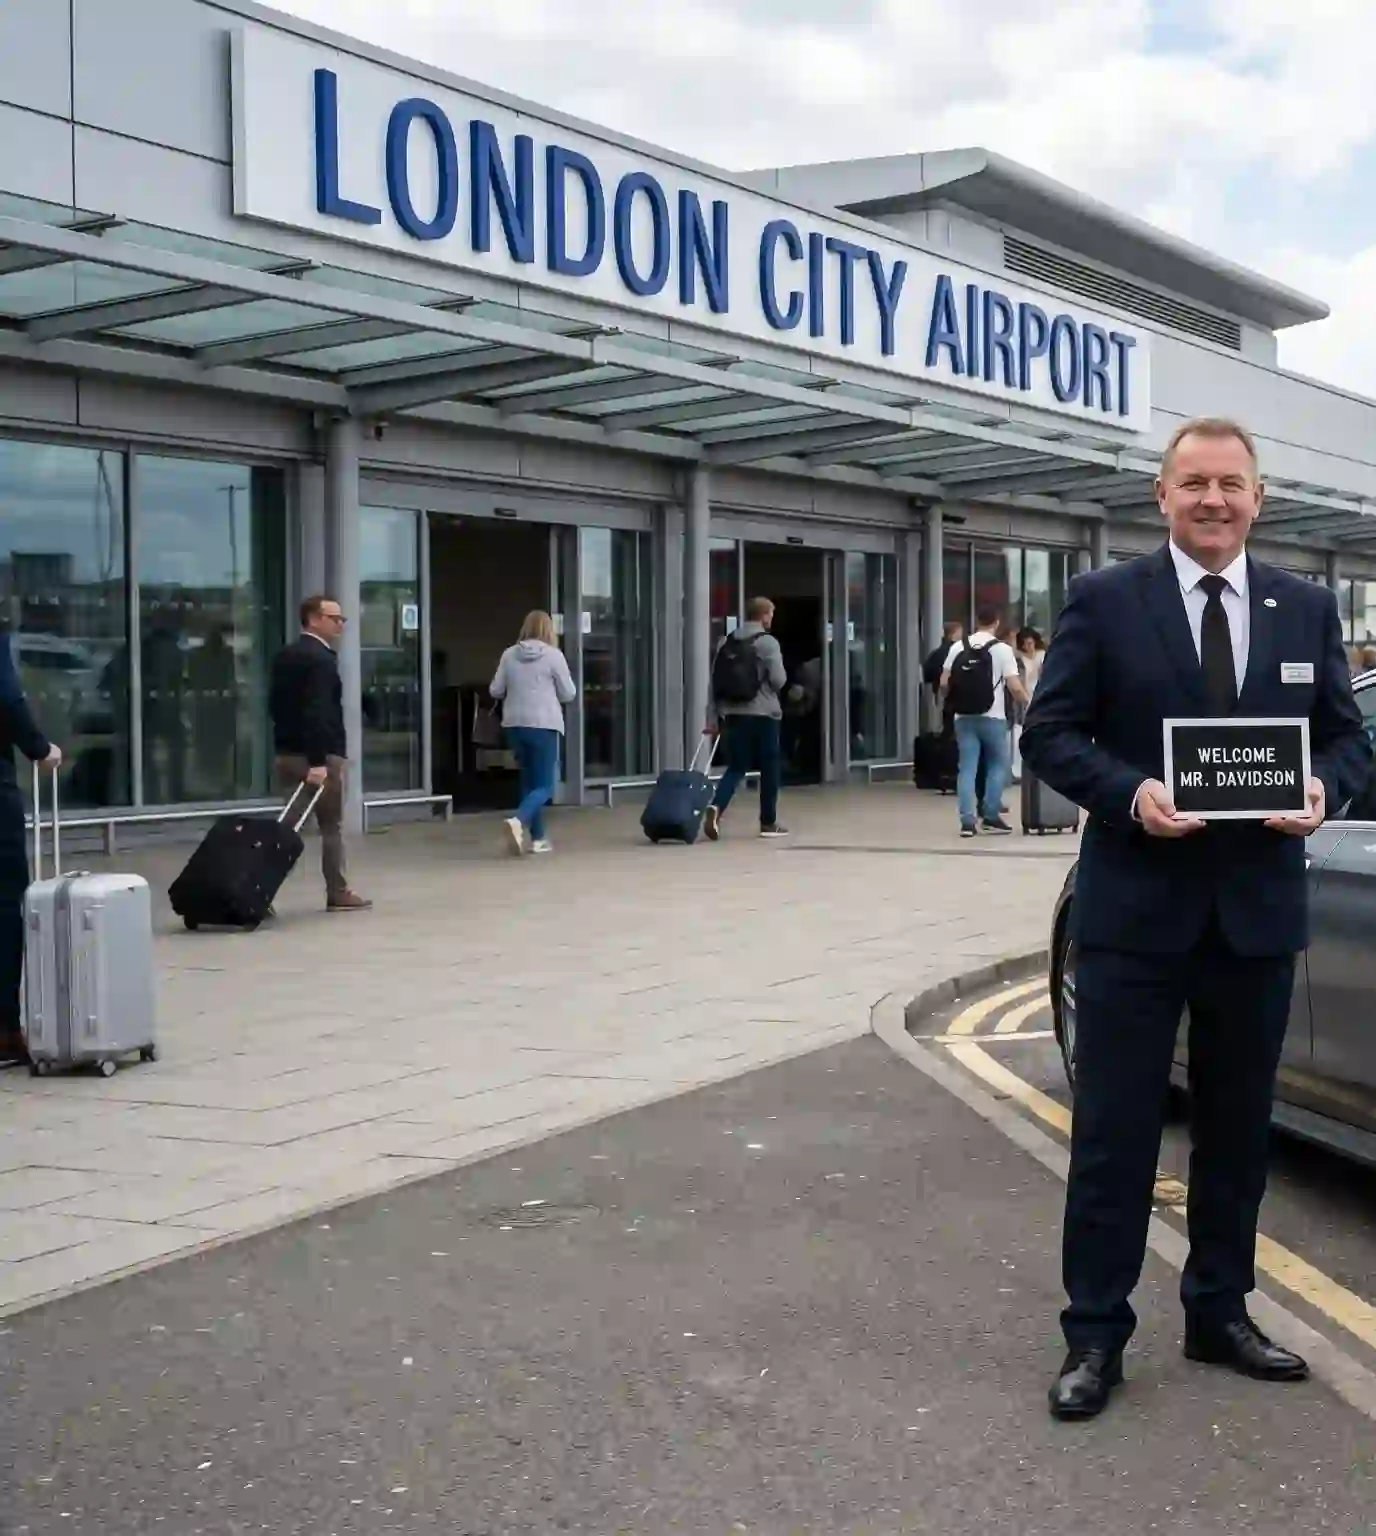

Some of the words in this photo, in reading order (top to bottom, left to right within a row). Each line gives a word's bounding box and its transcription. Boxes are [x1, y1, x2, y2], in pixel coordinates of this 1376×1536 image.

[314, 68, 730, 314] LONDON
[759, 219, 907, 356] CITY
[925, 274, 1137, 417] AIRPORT
[1197, 747, 1275, 763] WELCOME
[1180, 771, 1209, 786] MR.
[1216, 770, 1295, 786] DAVIDSON
